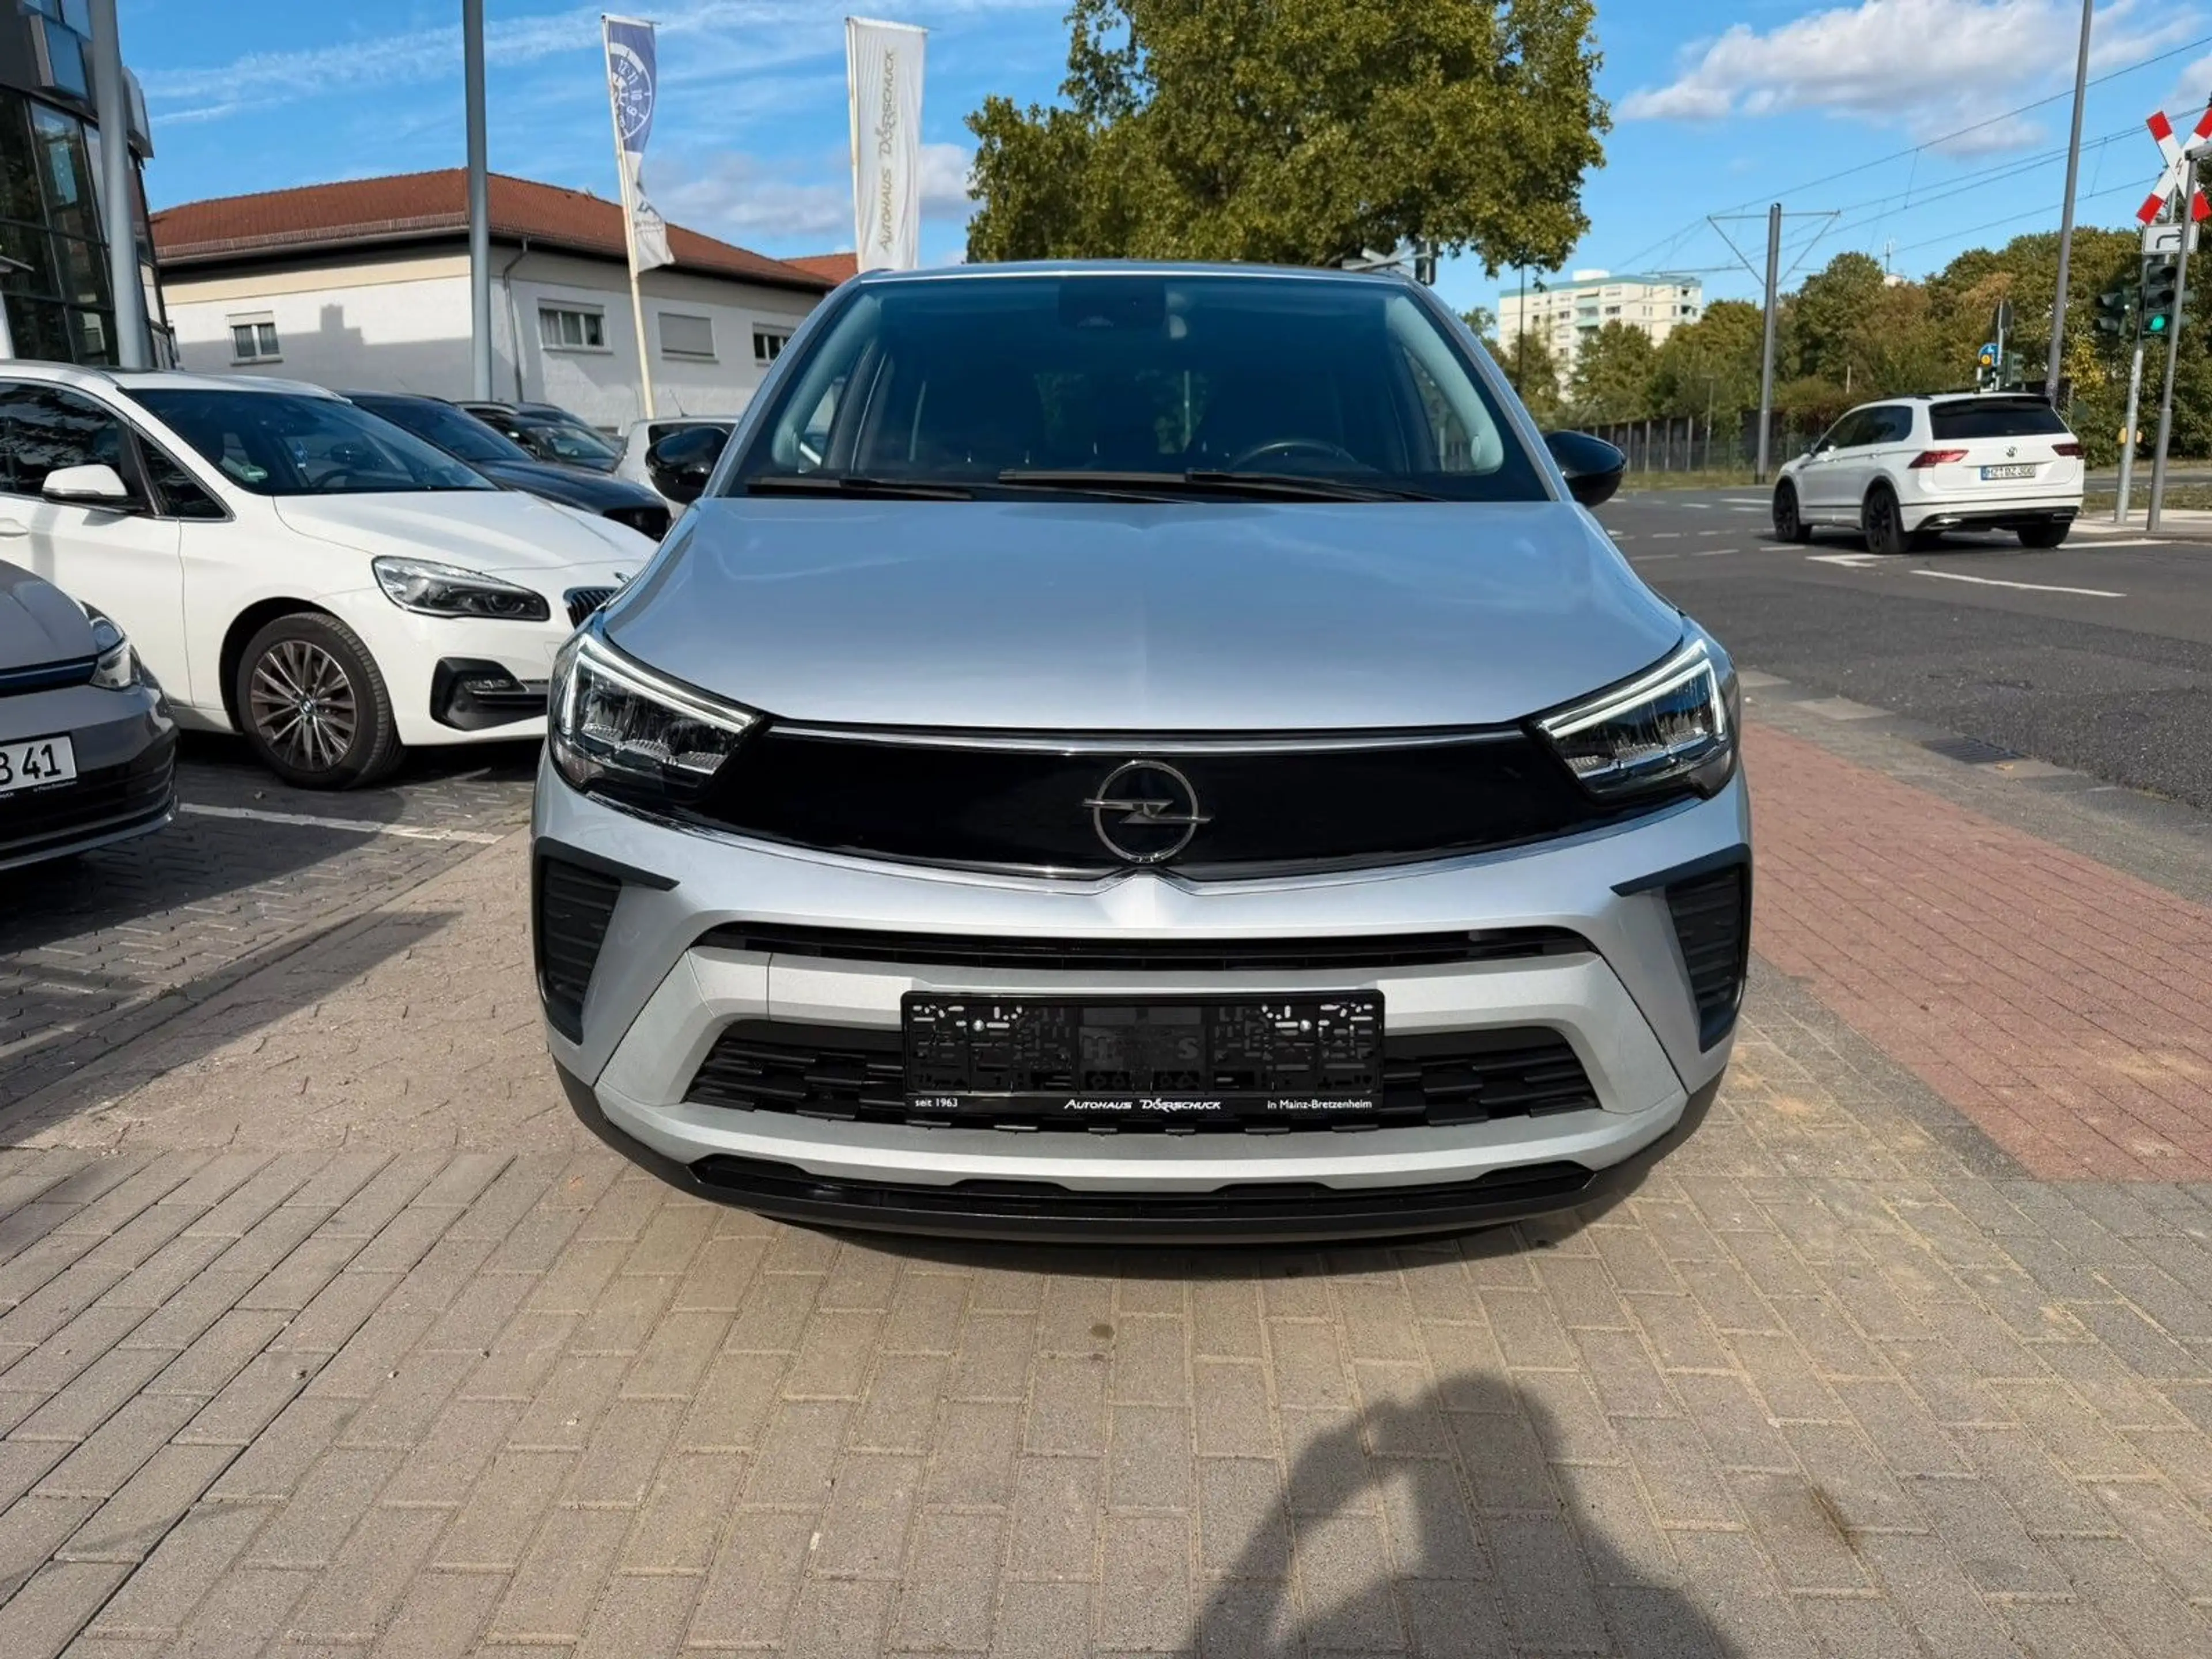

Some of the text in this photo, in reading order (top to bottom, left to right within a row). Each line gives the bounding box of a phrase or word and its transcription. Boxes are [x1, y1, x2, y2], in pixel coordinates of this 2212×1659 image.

[22, 744, 62, 779] 41
[915, 1097, 958, 1108] seit 1963
[1064, 1099, 1132, 1109] AUTOHAUS
[1279, 1099, 1373, 1109] Mainz-Bretzenheim
